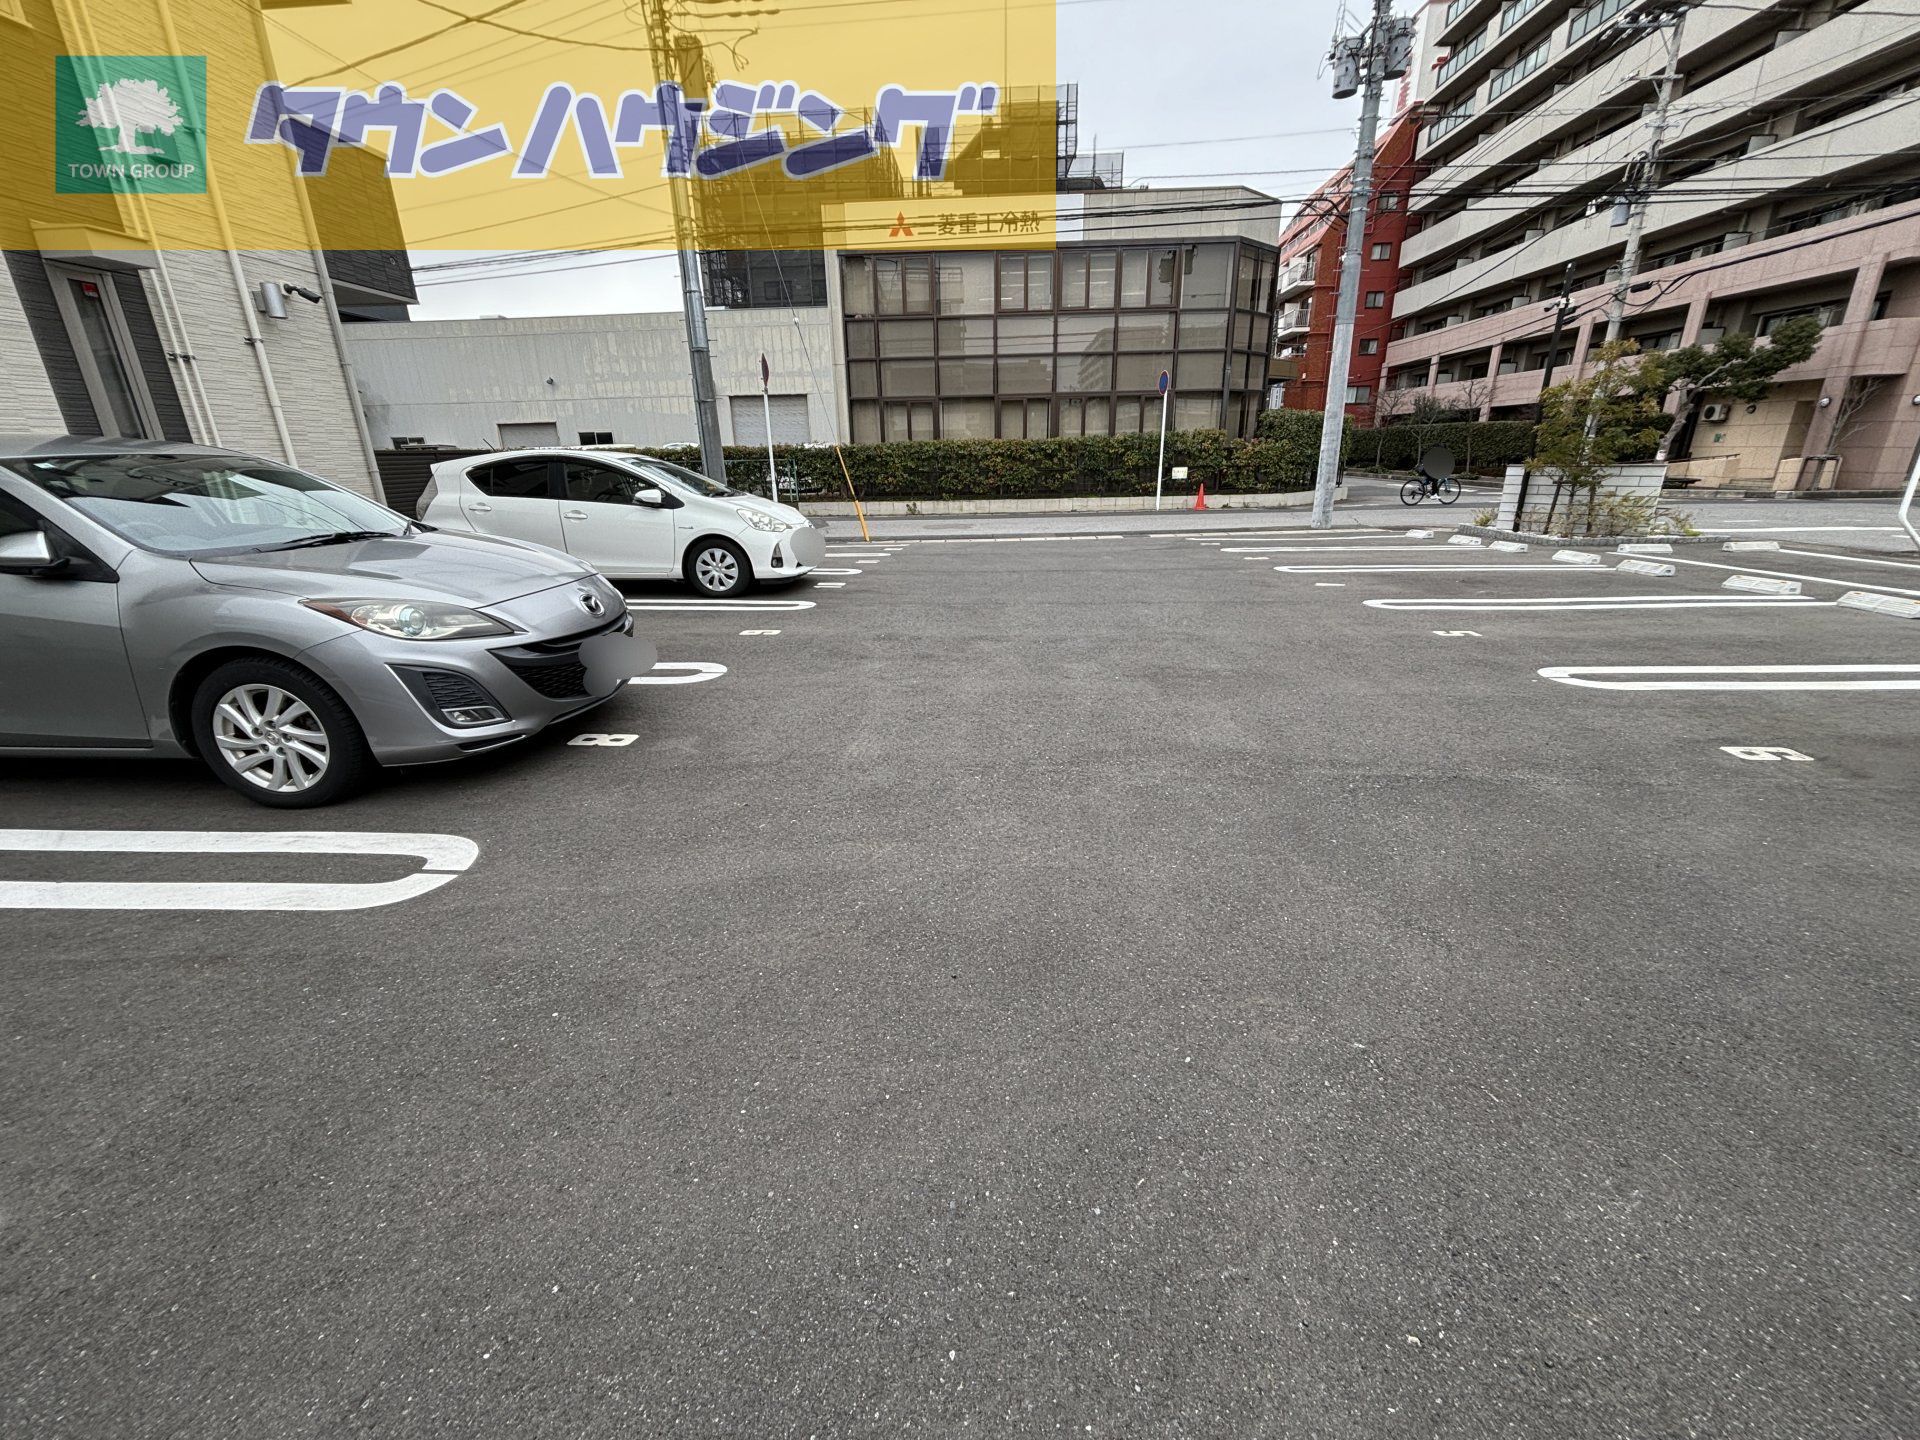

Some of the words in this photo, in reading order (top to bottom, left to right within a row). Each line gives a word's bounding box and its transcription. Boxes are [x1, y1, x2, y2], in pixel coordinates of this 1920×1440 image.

[916, 210, 1041, 236] 三菱重工冷熱
[566, 733, 640, 747] 8
